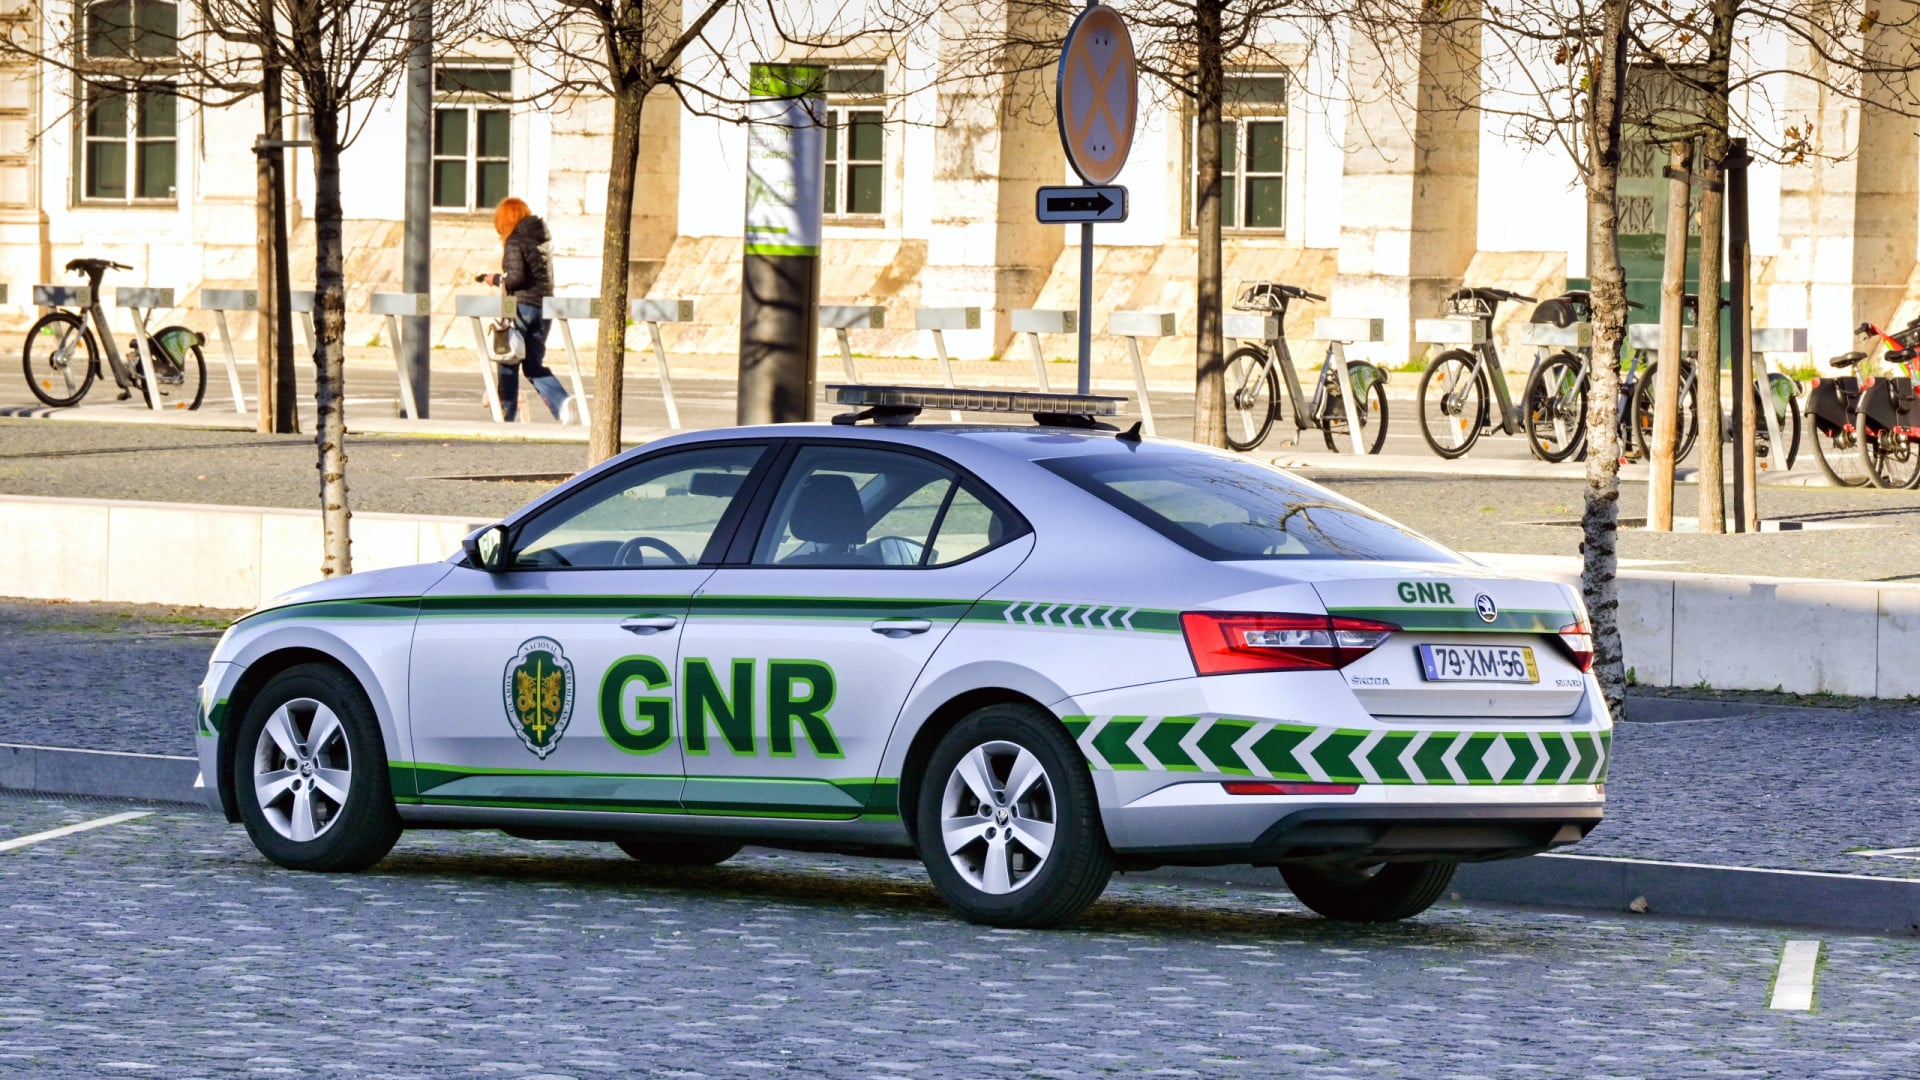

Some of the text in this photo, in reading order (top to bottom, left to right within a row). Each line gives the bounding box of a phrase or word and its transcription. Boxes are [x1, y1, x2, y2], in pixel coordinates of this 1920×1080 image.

[1397, 582, 1455, 604] GNR
[506, 675, 514, 713] GUARDA
[524, 642, 557, 654] NACIONAL
[597, 655, 846, 760] GNR
